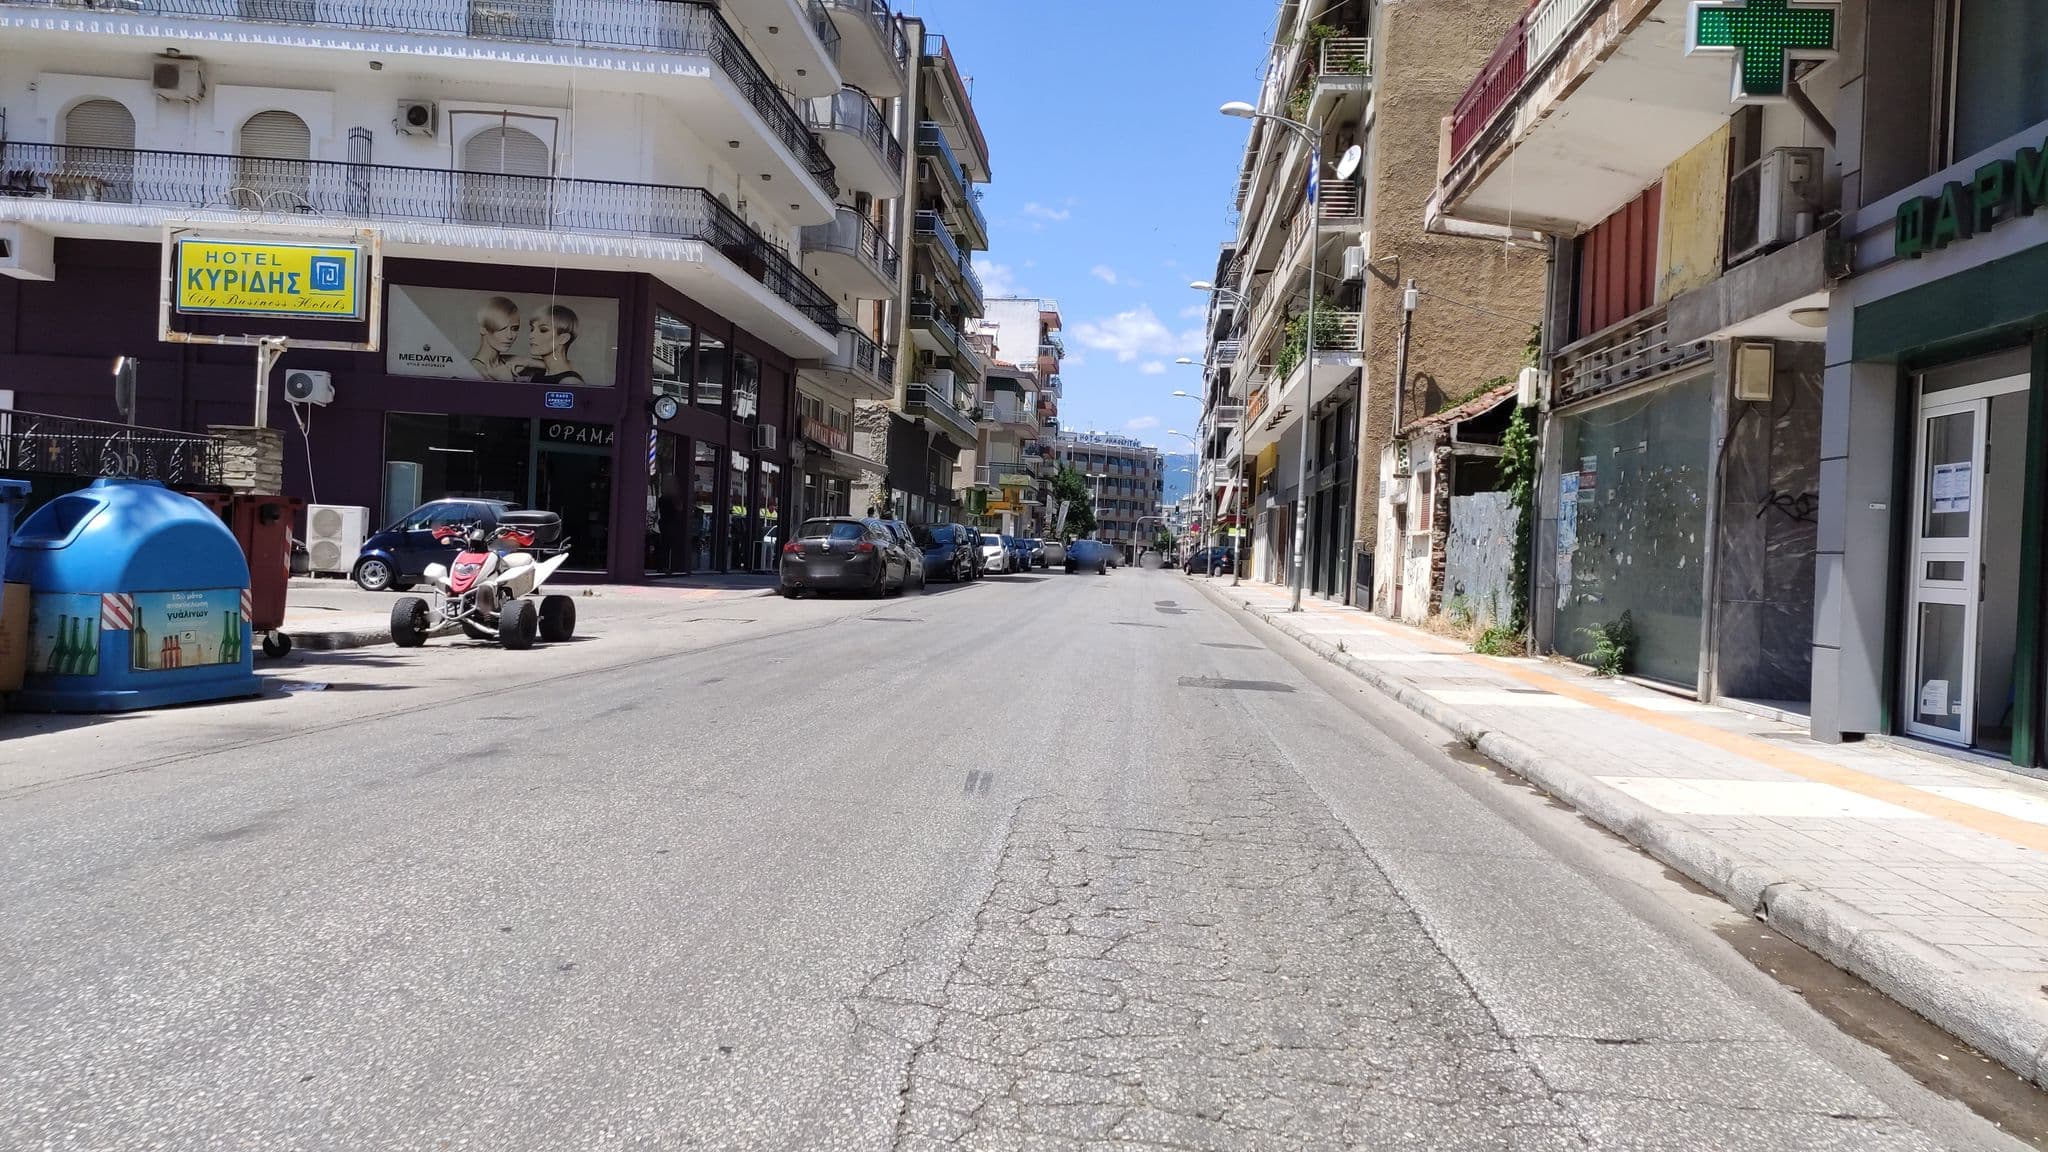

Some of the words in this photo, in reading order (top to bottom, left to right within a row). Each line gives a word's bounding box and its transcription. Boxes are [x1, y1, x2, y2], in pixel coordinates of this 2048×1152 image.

[206, 250, 283, 267] HOTEL
[187, 267, 302, 295] ΚΥΡΙΔΗΣ
[187, 291, 216, 307] City
[222, 293, 288, 309] Business
[293, 296, 346, 311] Hotels
[398, 353, 454, 363] MEDAVITA
[549, 424, 614, 444] ΟΡΑΜΑ
